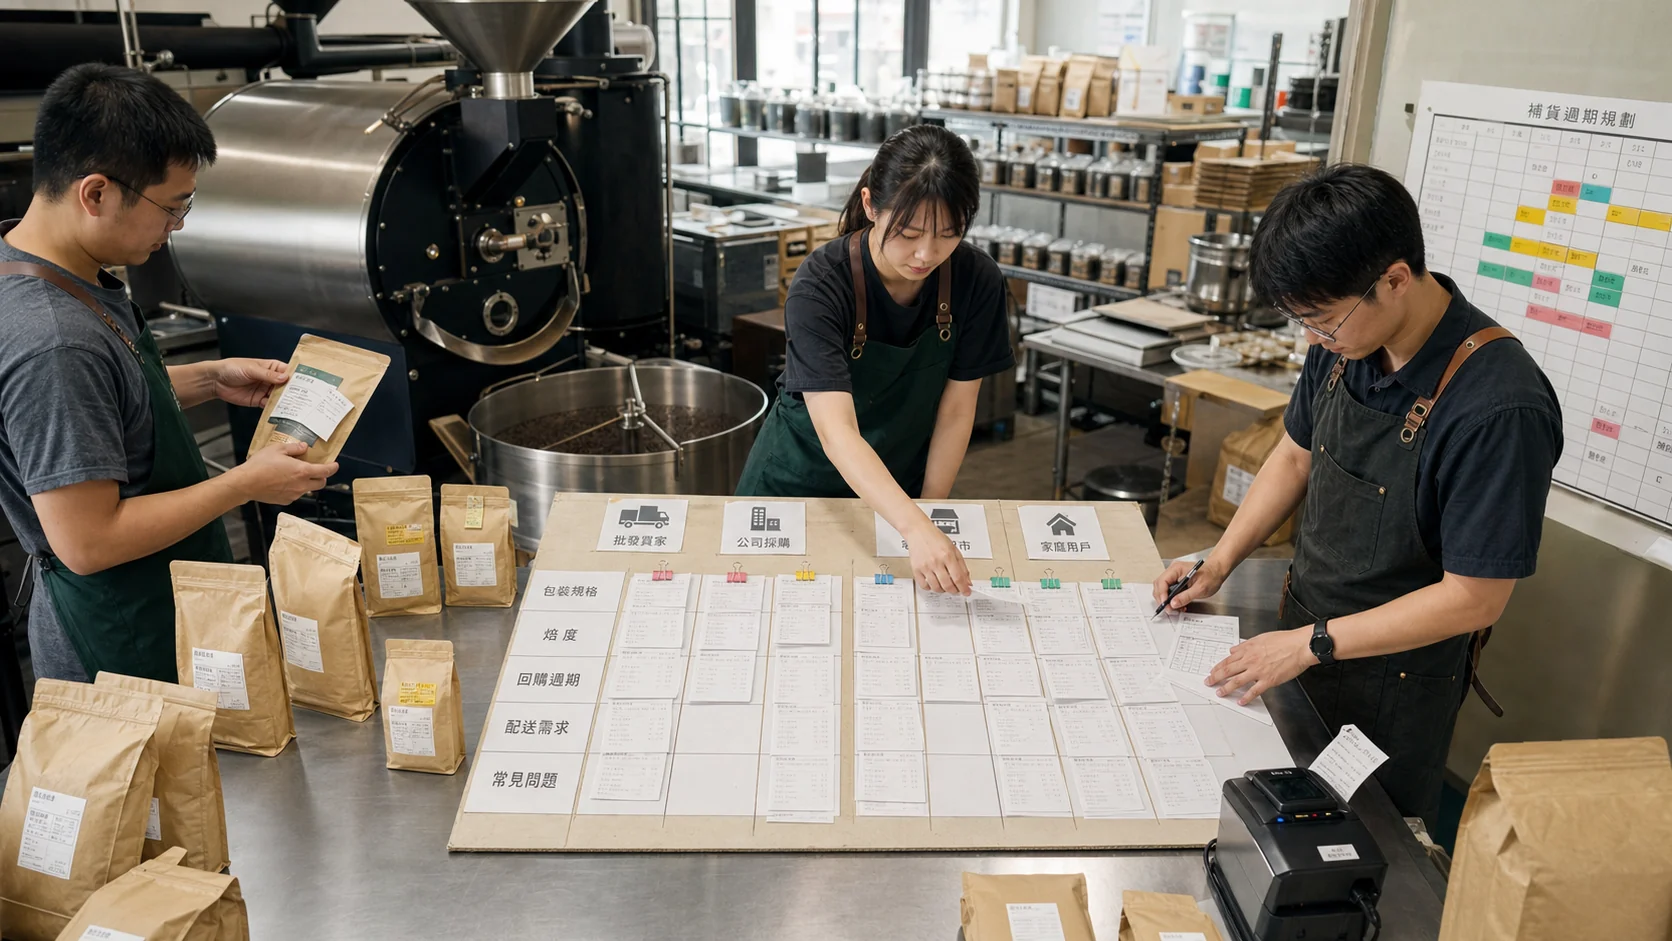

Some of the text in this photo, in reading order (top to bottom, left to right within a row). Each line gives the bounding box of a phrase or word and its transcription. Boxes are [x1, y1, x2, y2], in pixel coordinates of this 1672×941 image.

[1528, 102, 1637, 129] 補貨週期規劃
[737, 537, 791, 548] 公司採購
[543, 585, 598, 597] 包裝規格
[517, 672, 581, 687] 回購週期
[504, 719, 570, 735] 配送需求
[492, 770, 559, 789] 常見問題
